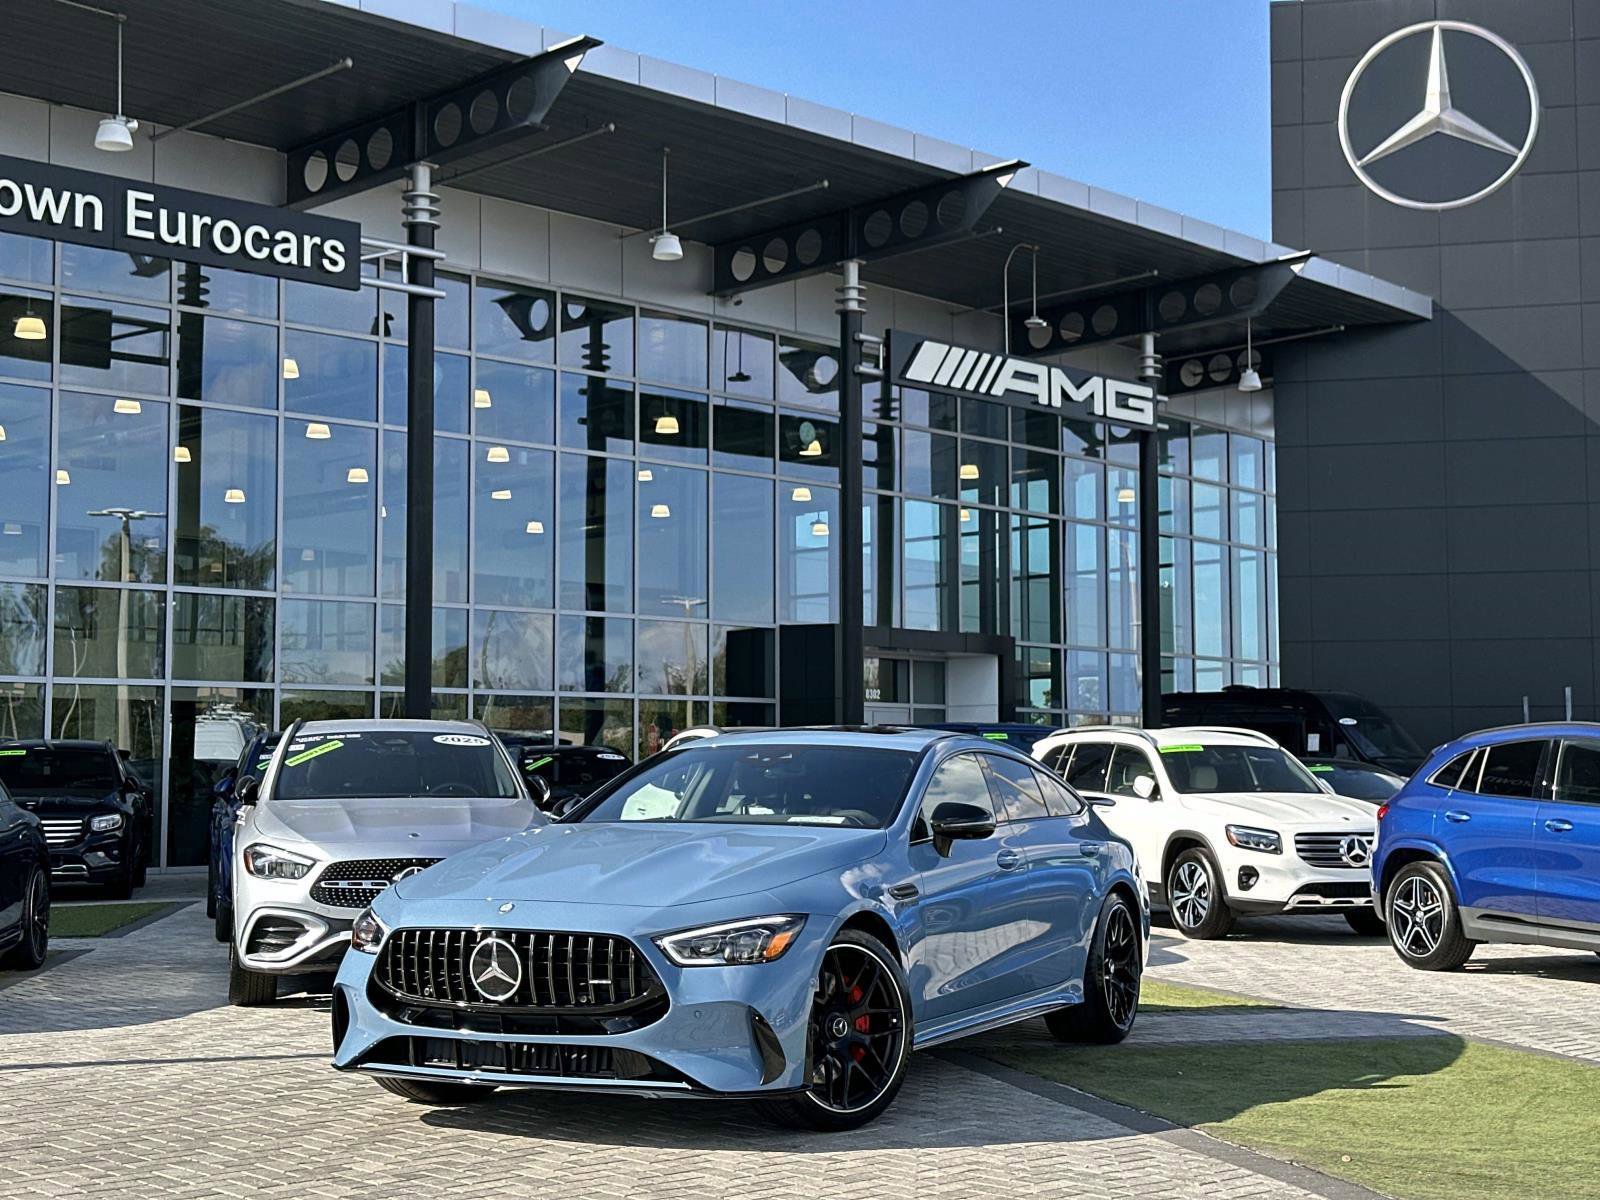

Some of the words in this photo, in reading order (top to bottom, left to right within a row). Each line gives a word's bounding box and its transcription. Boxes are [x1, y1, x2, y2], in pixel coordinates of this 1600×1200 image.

[0, 178, 104, 232] own
[126, 189, 347, 274] Eurocars
[990, 358, 1153, 425] AMG
